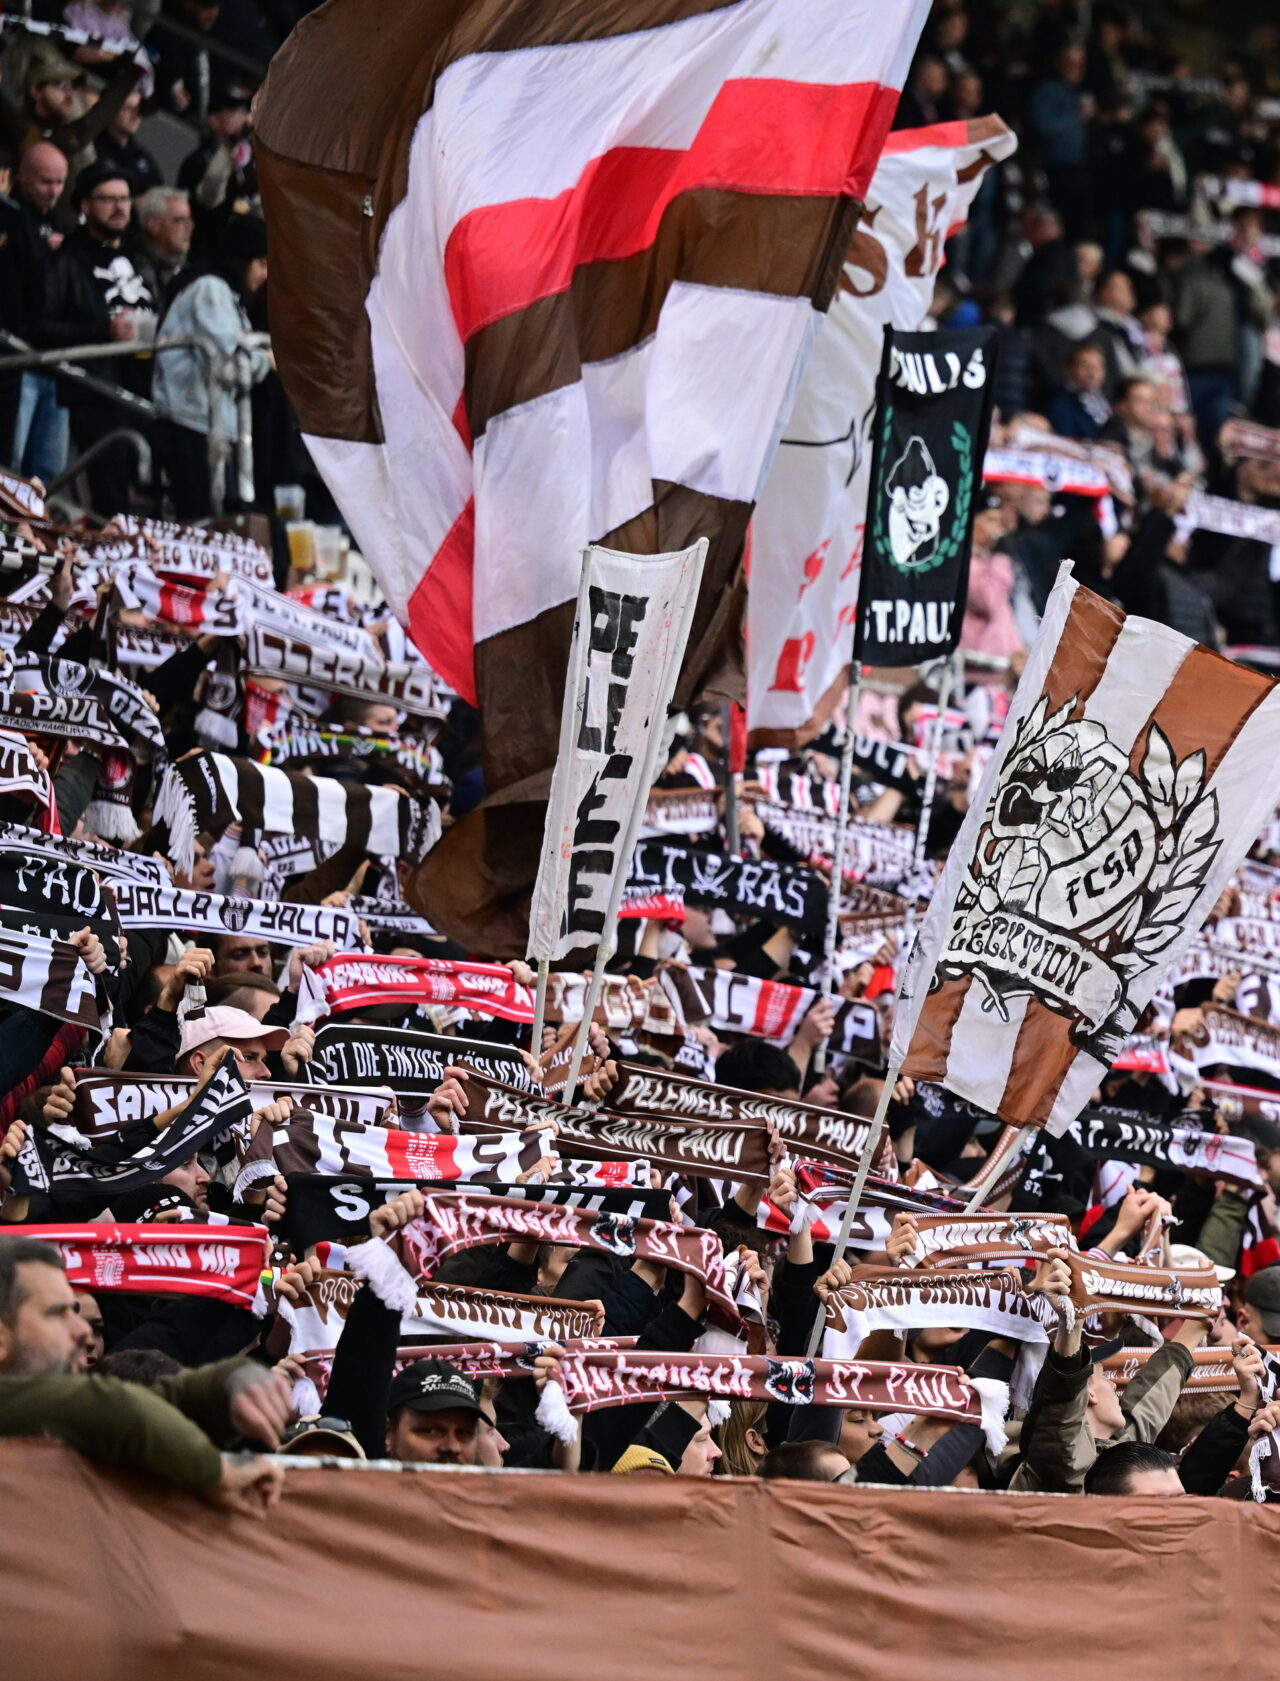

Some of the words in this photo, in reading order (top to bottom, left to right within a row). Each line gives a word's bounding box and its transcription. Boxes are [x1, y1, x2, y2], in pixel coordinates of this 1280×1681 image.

[117, 886, 213, 921] YALLA
[260, 903, 351, 946] YALLA
[351, 1041, 380, 1079] DIE
[381, 1043, 444, 1081] EINZIGE
[615, 1074, 738, 1120] PELEMELE
[815, 1115, 871, 1157] PAUL
[600, 1117, 679, 1157] SANKT
[676, 1129, 746, 1166] PAULI
[131, 1243, 192, 1269] SIND
[197, 1243, 241, 1278] WIR
[916, 1272, 996, 1310] SANKT
[560, 1349, 755, 1406] Blutrausch
[825, 1361, 874, 1402] ST.
[886, 1366, 971, 1411] PAULI
